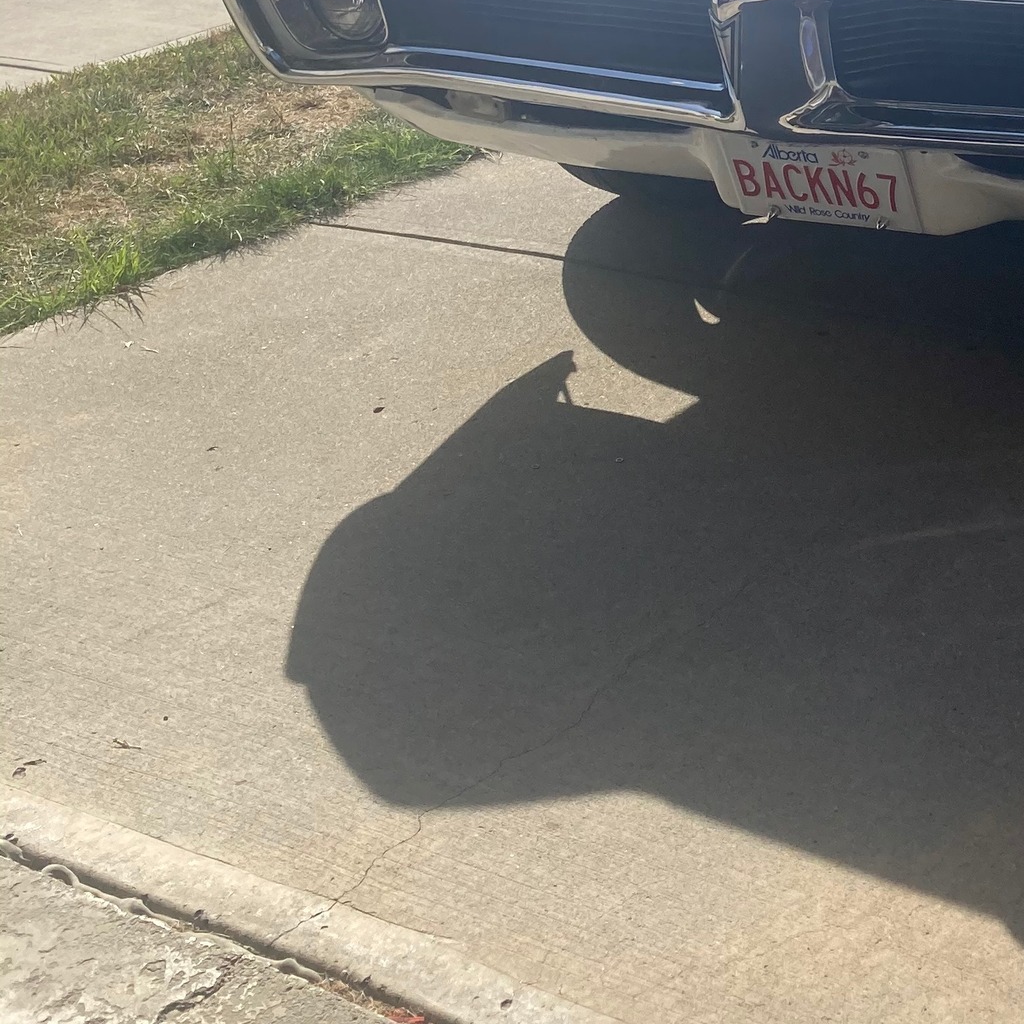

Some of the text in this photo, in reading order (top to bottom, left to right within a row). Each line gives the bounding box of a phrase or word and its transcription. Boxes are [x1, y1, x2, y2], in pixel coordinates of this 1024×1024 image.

[762, 144, 819, 164] Alberta
[732, 159, 898, 212] BACKN67
[785, 204, 870, 222] Wild Rose Country
